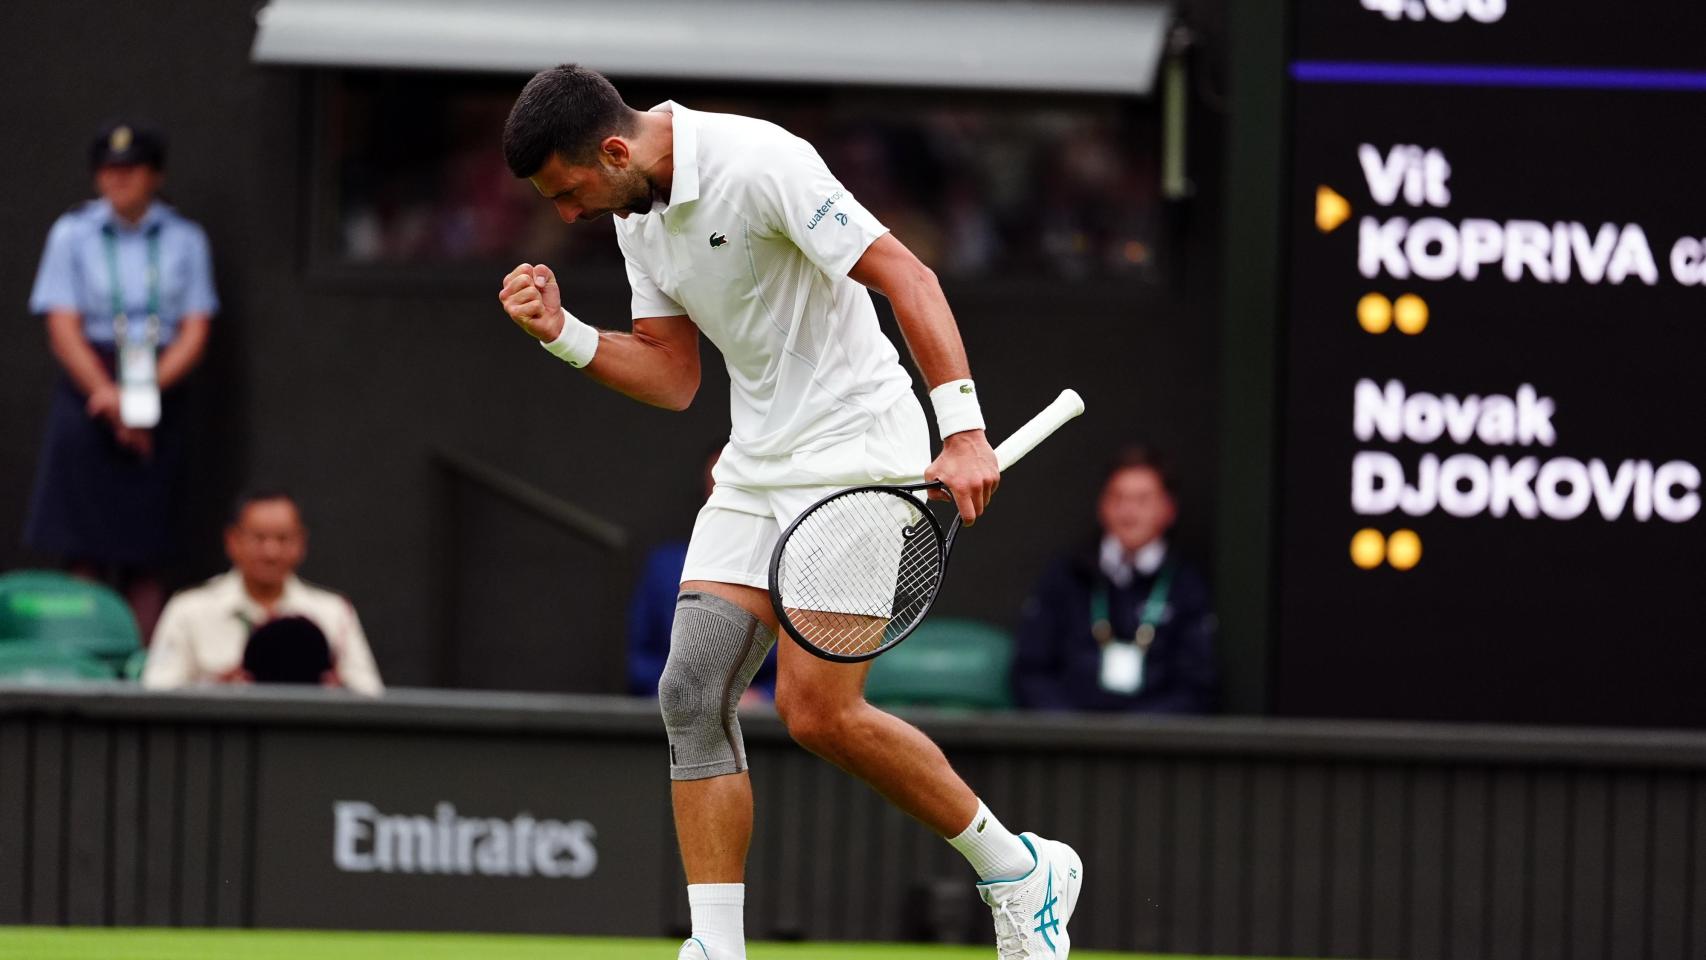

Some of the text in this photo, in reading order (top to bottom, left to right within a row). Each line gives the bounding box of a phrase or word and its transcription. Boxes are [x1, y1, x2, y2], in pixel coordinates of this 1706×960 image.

[1358, 143, 1451, 208] Vit
[1357, 216, 1706, 286] KOPRIVA C
[1353, 378, 1556, 446] Novak
[1350, 450, 1702, 523] DJOKOVIC
[333, 800, 598, 878] Emirates
